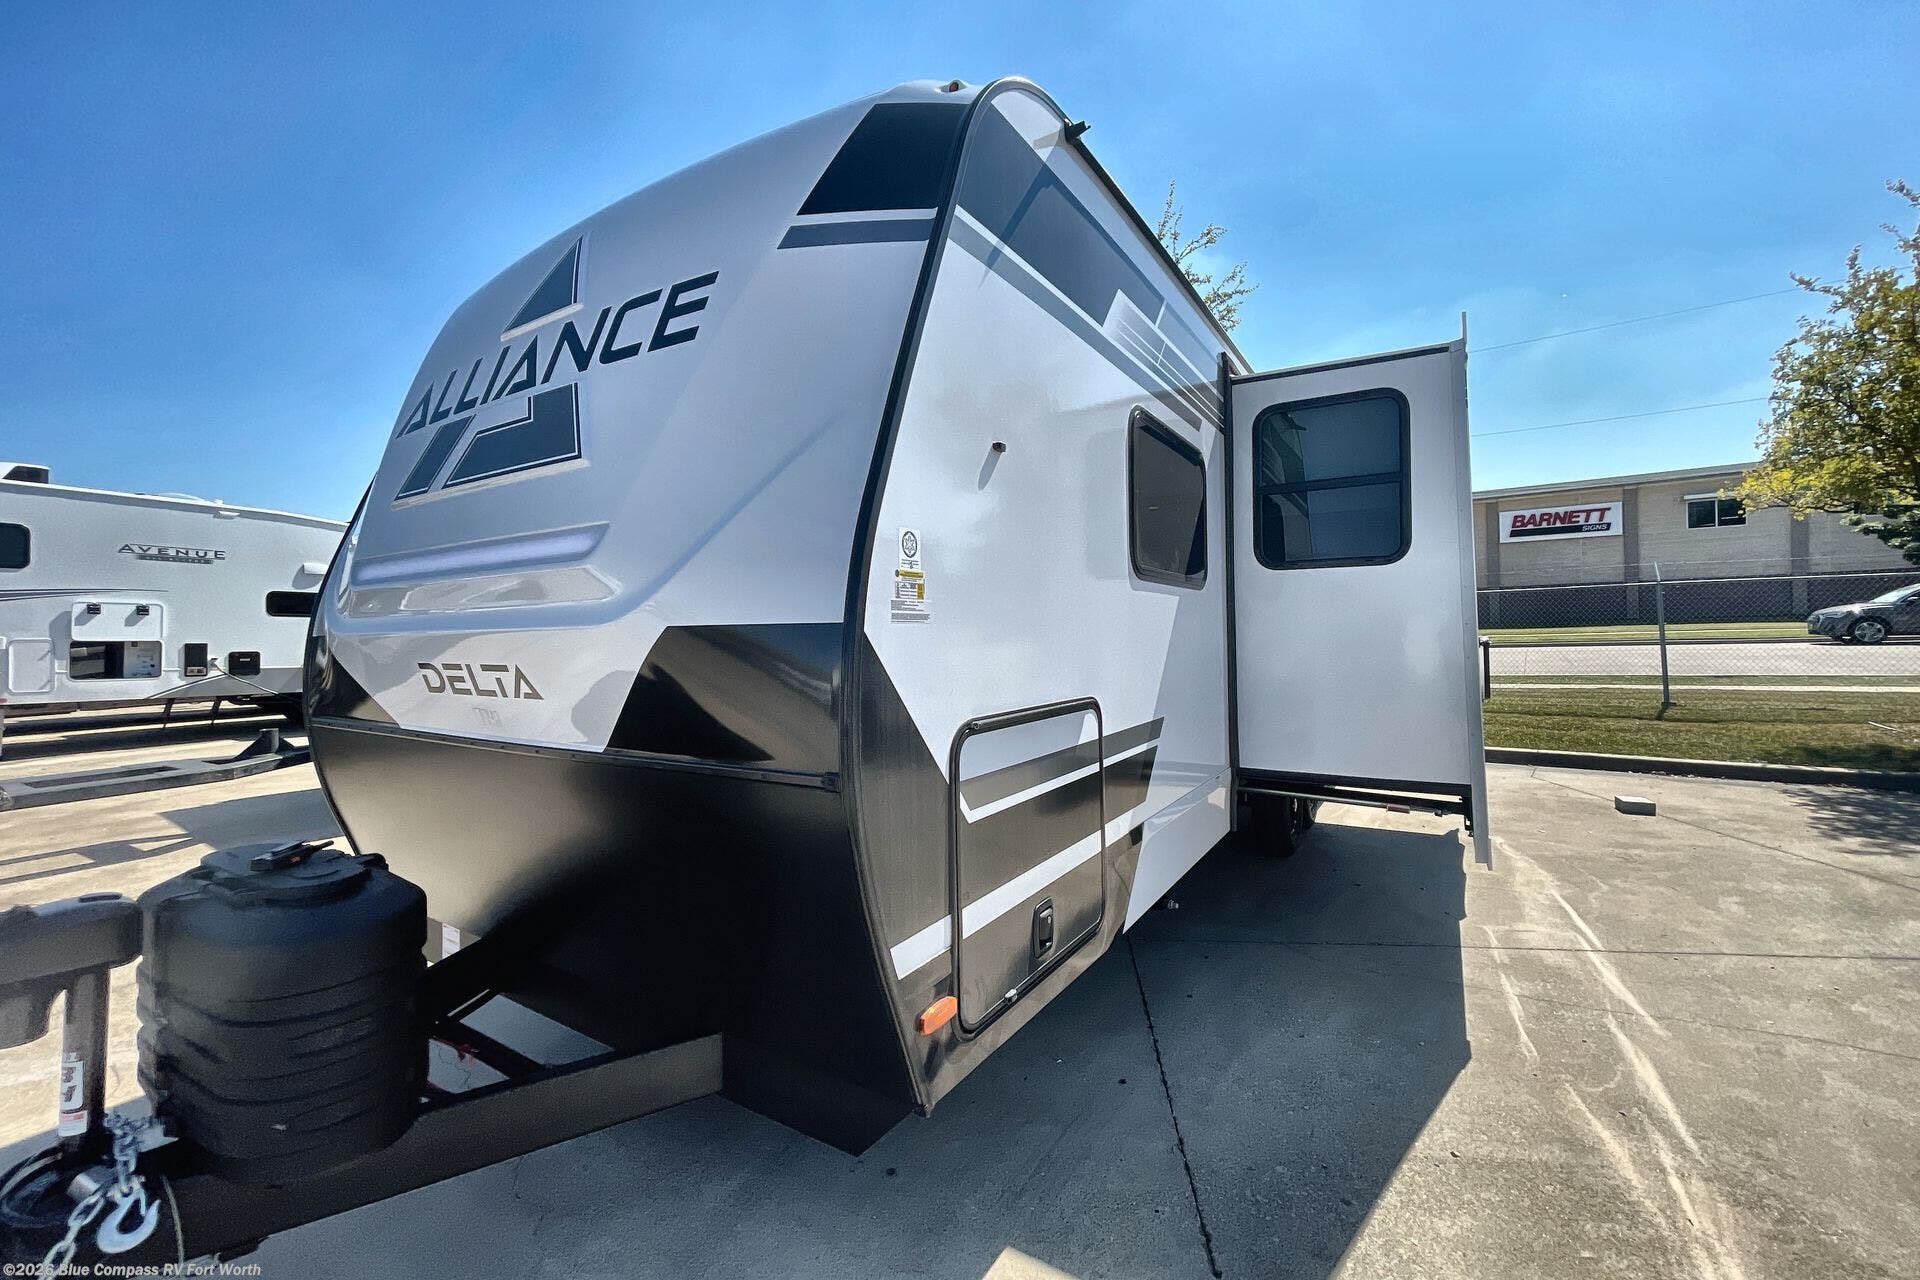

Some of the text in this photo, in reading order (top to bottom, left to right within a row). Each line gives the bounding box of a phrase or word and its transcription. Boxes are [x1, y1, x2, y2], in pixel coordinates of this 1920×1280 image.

[396, 270, 719, 438] ALLIANCE
[1511, 507, 1611, 529] BARNETT
[1582, 523, 1608, 532] SIGNS
[118, 543, 226, 560] AVENUE
[417, 662, 545, 700] DELTA
